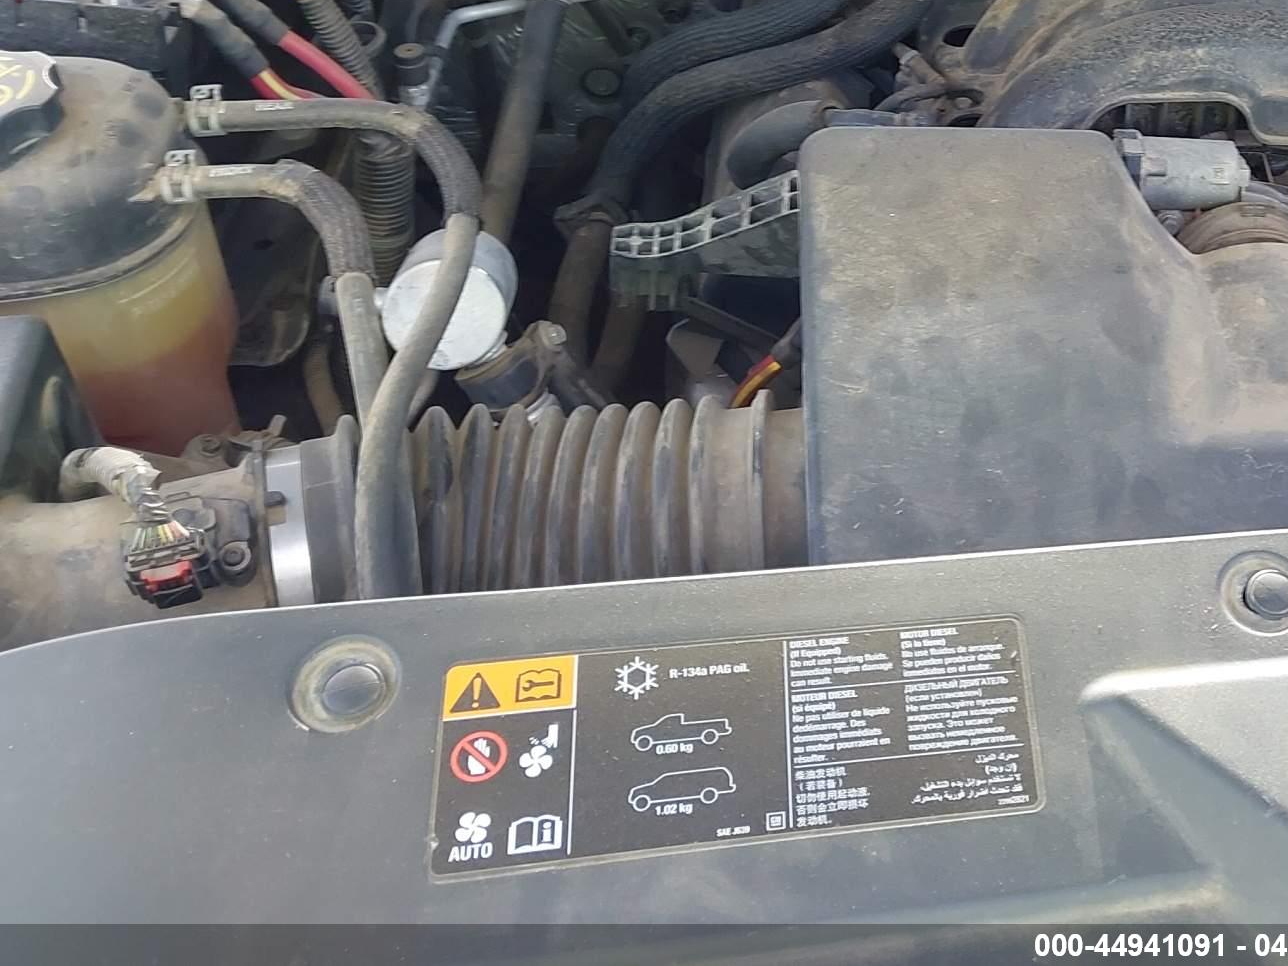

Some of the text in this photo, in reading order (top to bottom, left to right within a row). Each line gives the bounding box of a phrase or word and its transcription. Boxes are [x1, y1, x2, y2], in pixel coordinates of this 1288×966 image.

[789, 640, 817, 648] DIESEL
[669, 666, 708, 679] R-134a
[709, 664, 732, 675] PAG
[792, 690, 858, 702] MOTEUR DIESEL
[680, 742, 694, 753] kg
[655, 803, 693, 816] 1.02 kg
[448, 842, 493, 862] AUTO
